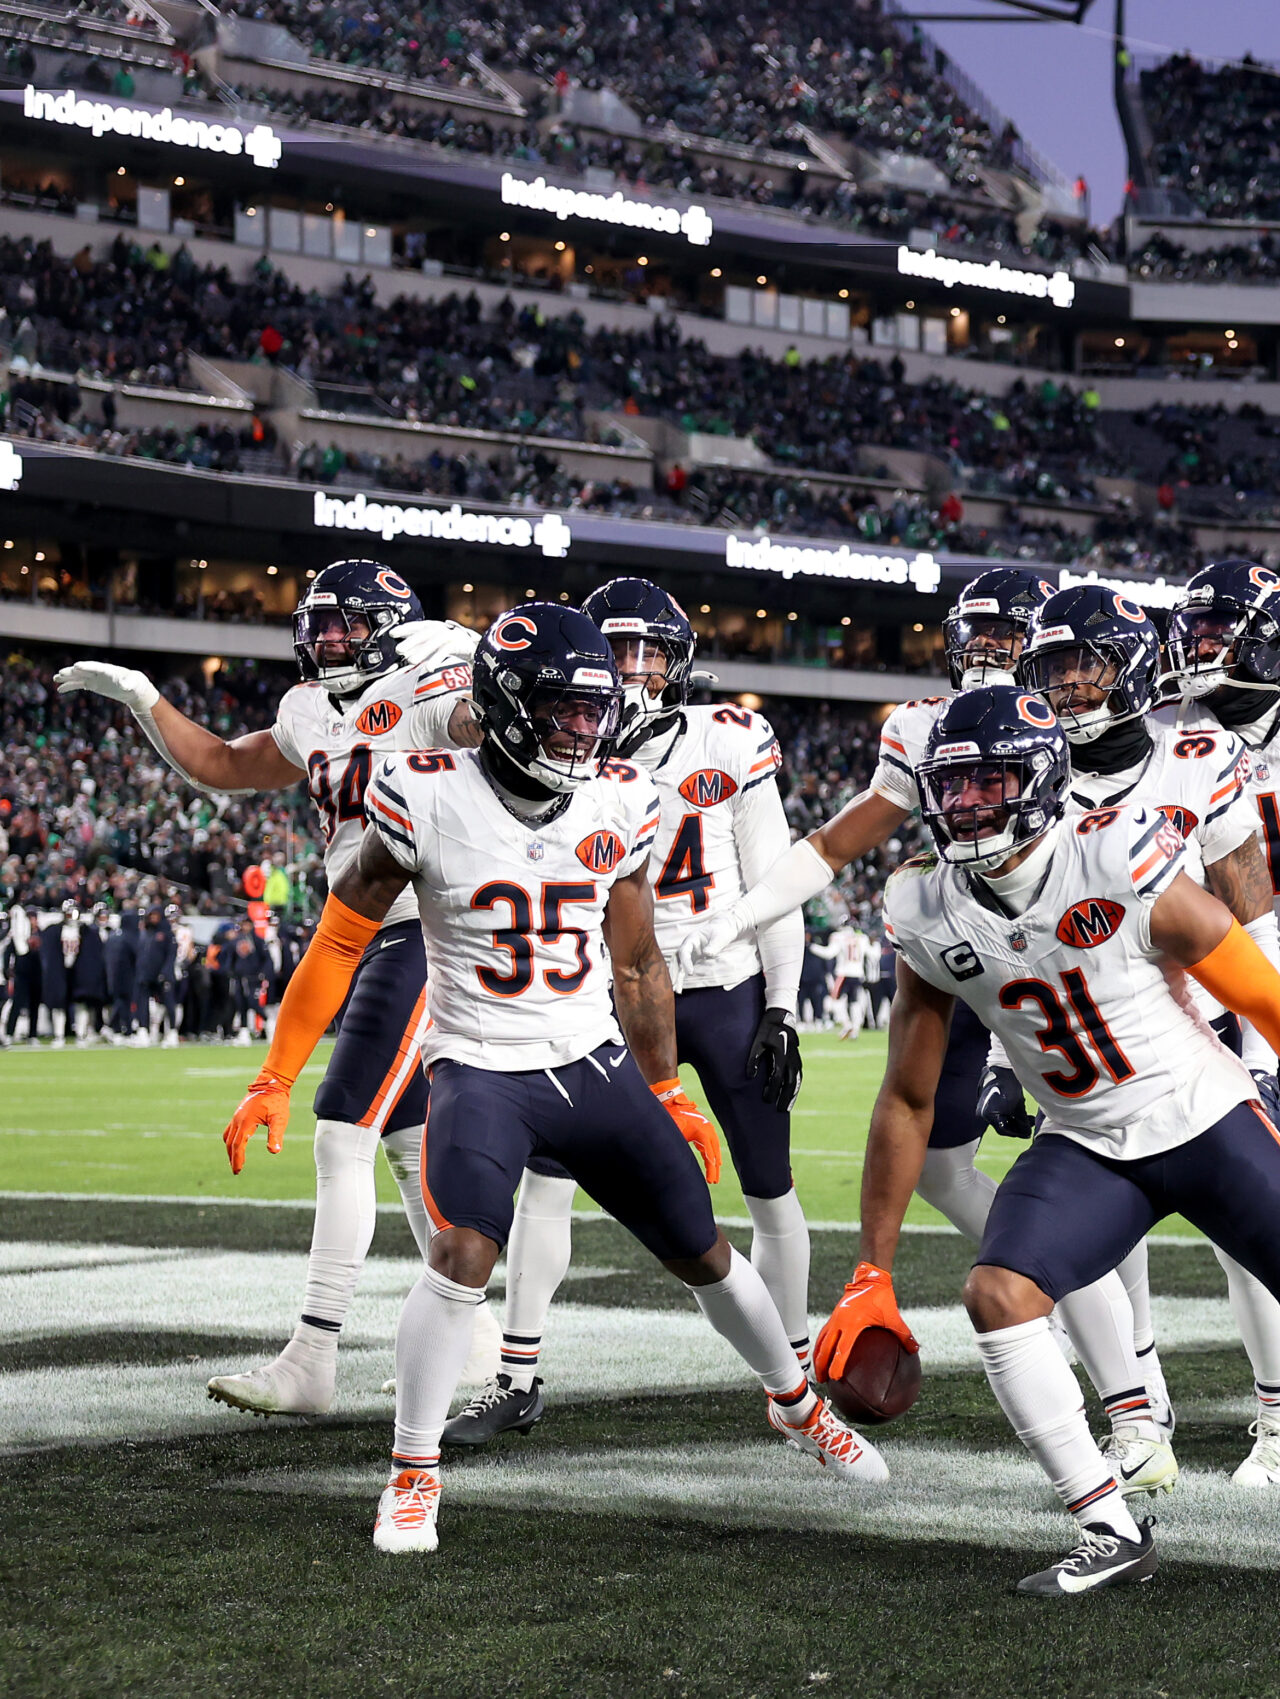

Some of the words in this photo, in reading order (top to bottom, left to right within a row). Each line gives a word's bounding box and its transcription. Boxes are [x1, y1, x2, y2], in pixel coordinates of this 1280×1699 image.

[24, 84, 243, 155] Independence
[501, 172, 681, 234] Independence
[898, 245, 1048, 298] Independence
[314, 491, 533, 547] Independence
[726, 534, 909, 584] Independence
[308, 742, 372, 845] 94
[470, 880, 596, 998] 35
[998, 966, 1137, 1098] 31
